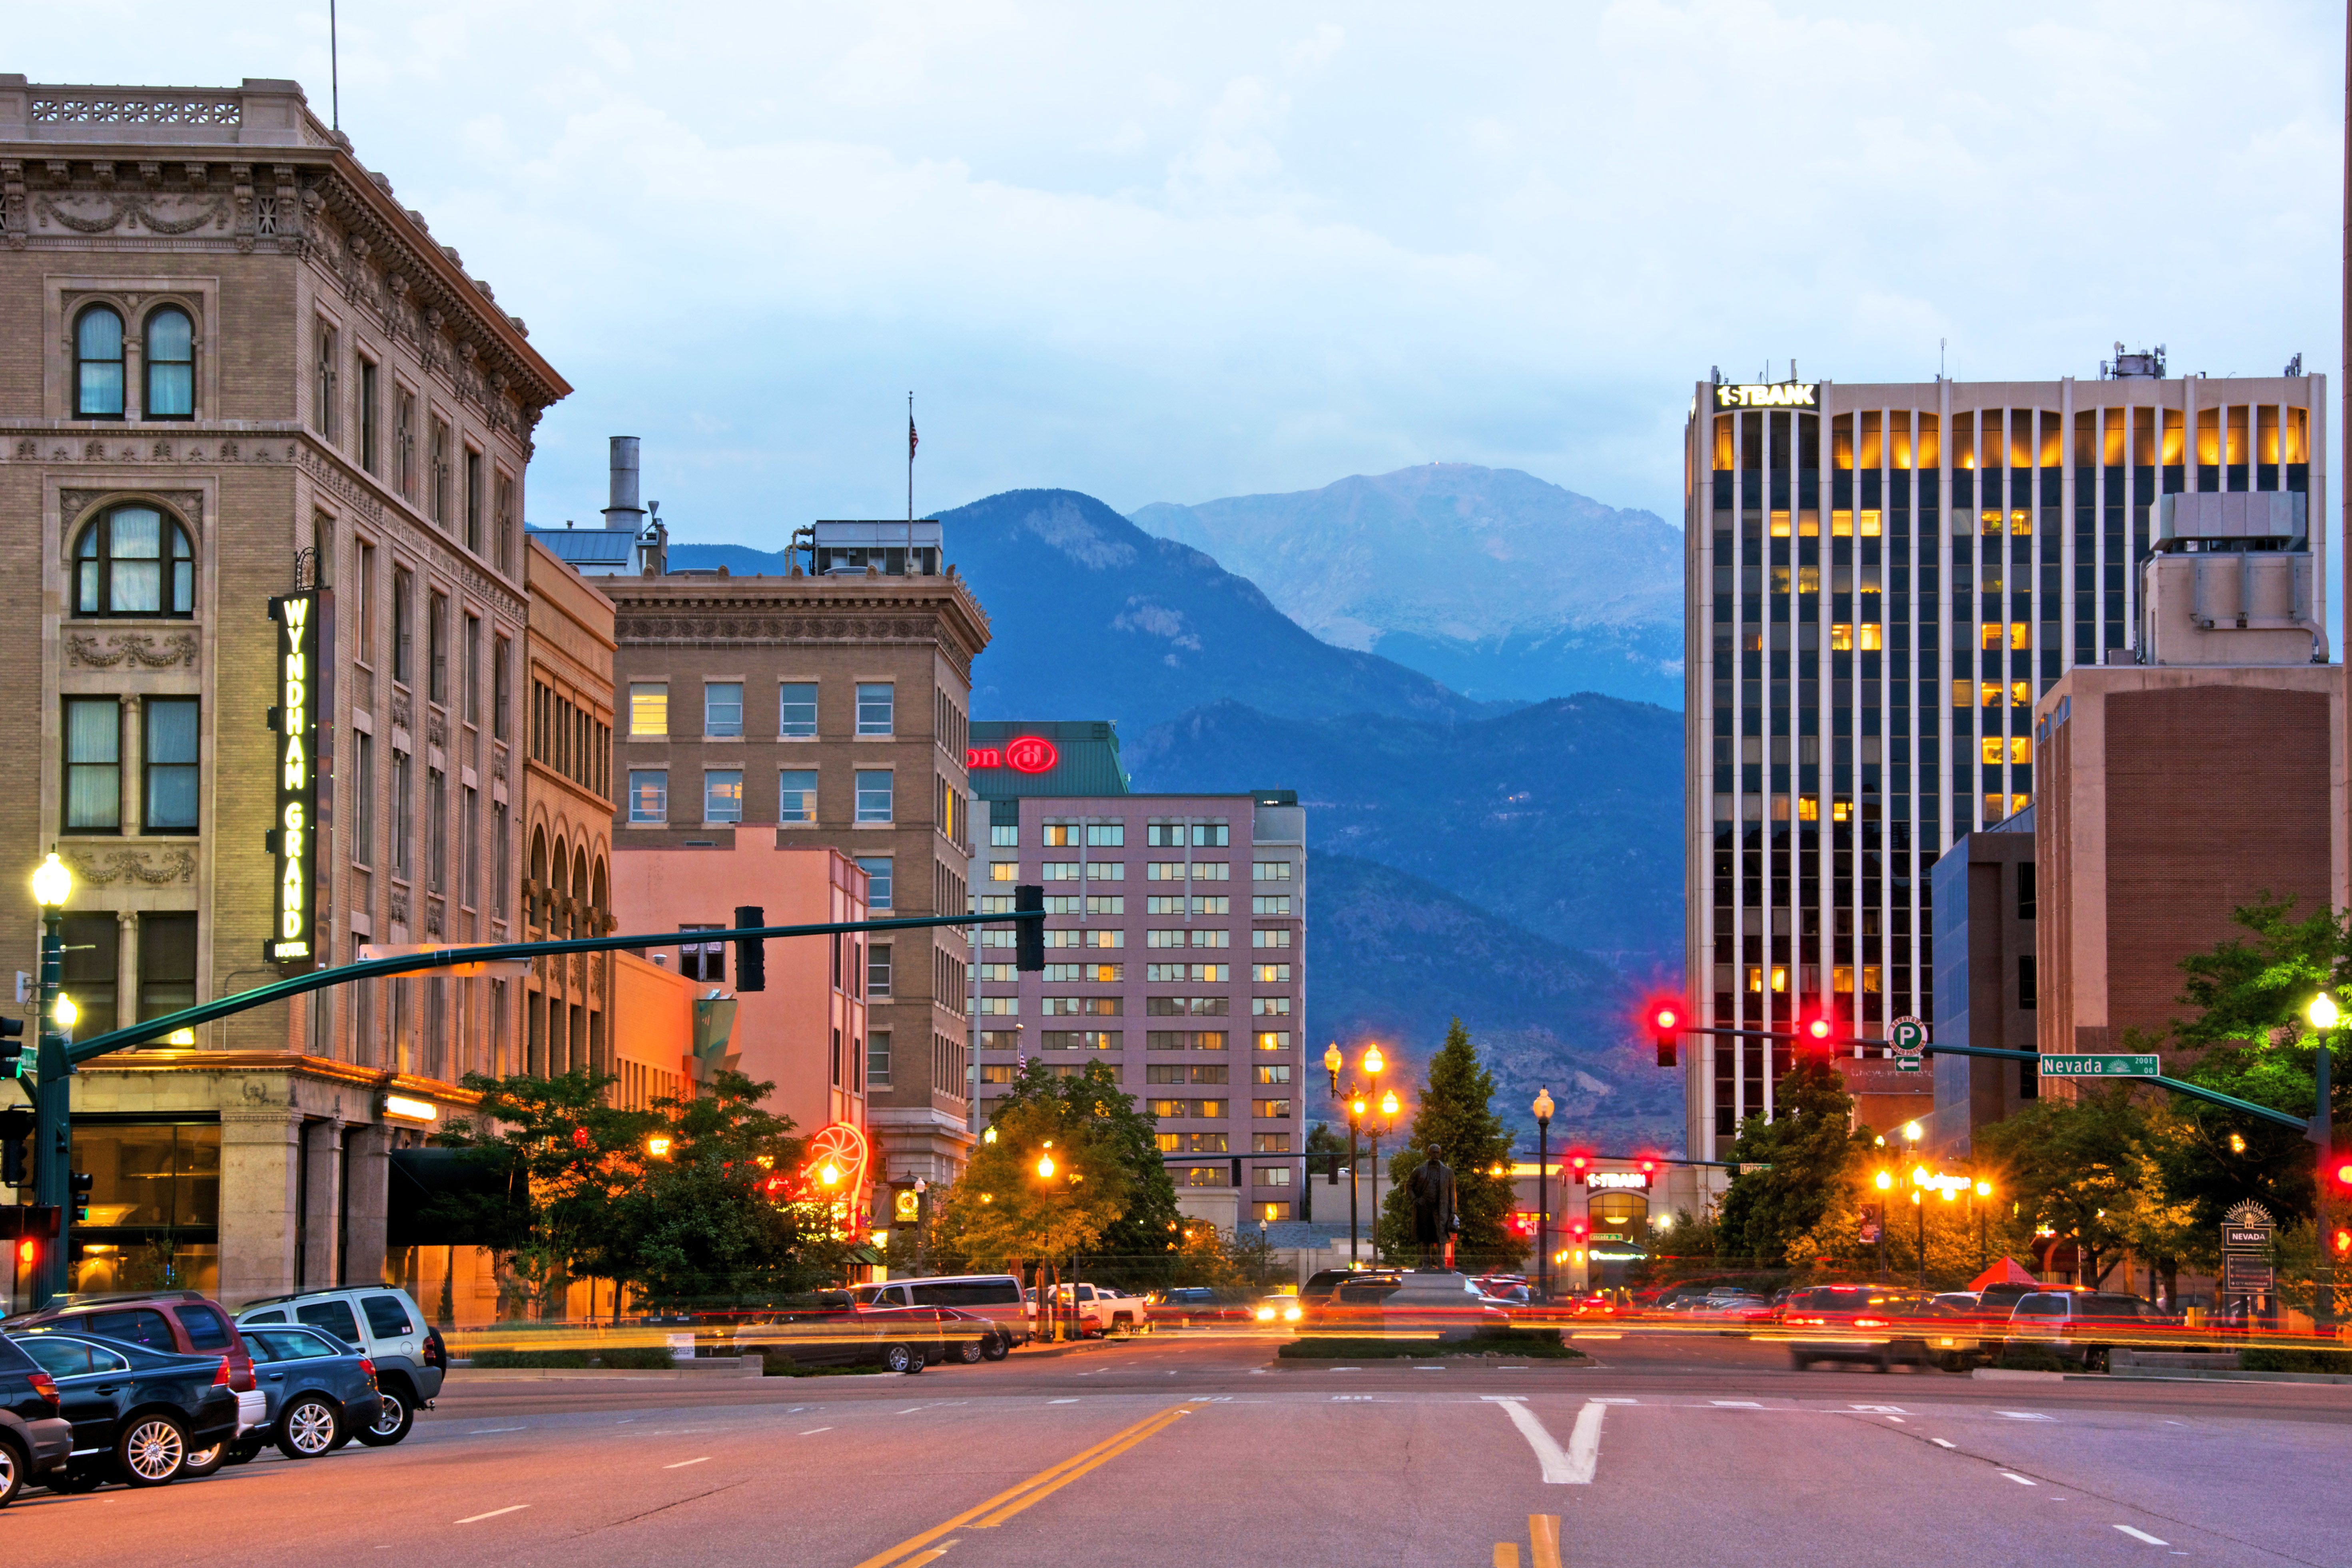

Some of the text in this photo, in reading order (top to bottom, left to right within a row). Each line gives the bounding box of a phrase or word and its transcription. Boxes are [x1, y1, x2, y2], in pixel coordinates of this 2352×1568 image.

[282, 598, 309, 939] WYNDHAM GRAND
[275, 942, 309, 958] HOTEL
[1890, 1016, 1924, 1028] DOWNTOWN
[1900, 1027, 1915, 1045] P
[1889, 1039, 1926, 1055] PUBLIC PARKING
[2044, 1058, 2102, 1073] Nevada
[2229, 1206, 2268, 1220] DOWNTOWN
